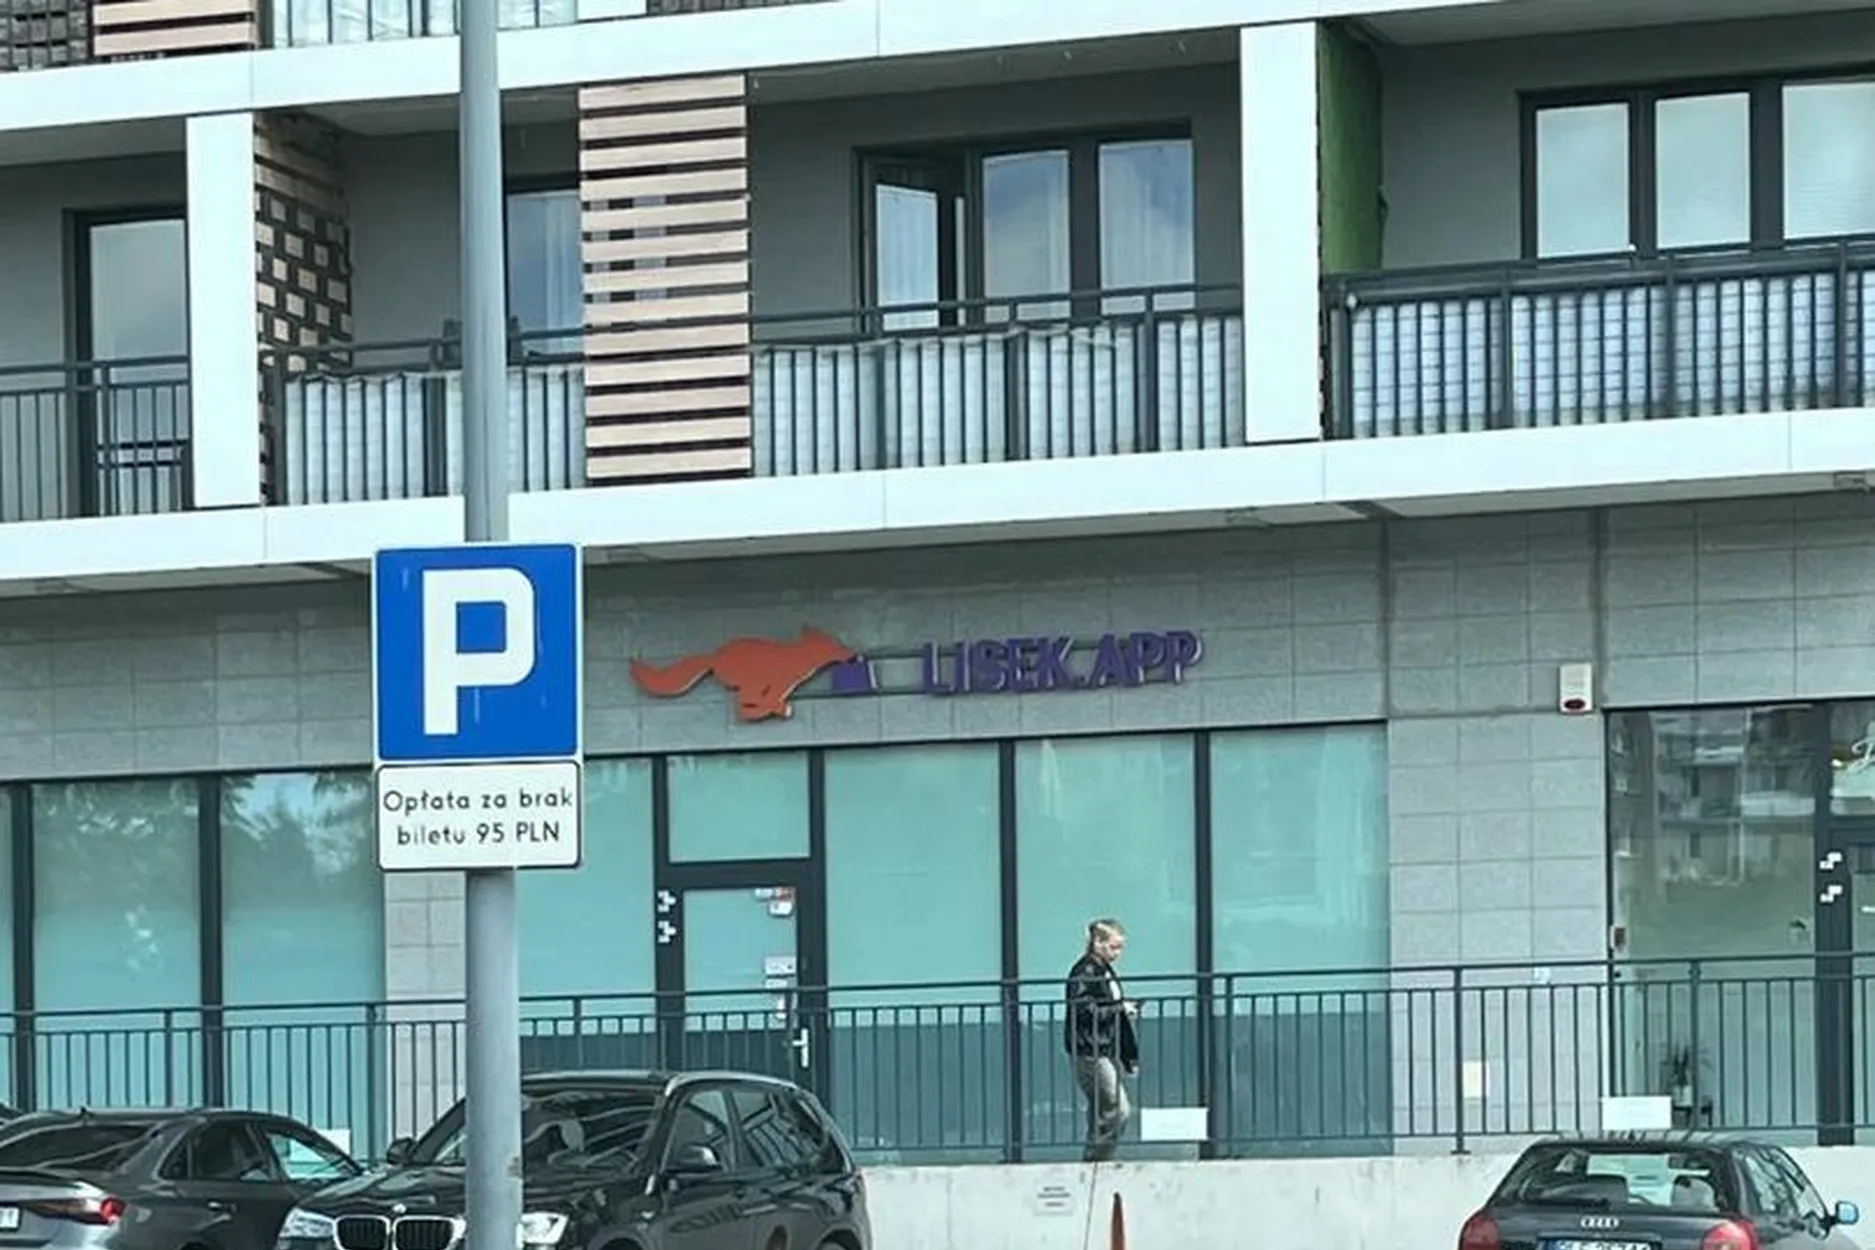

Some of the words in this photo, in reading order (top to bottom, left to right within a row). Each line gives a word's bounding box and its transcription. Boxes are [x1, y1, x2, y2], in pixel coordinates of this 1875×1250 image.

[423, 567, 535, 735] P
[383, 790, 470, 816] Opłata
[482, 792, 508, 809] za
[519, 788, 573, 808] brak
[397, 825, 467, 846] biletu
[477, 823, 505, 843] 95
[516, 822, 560, 842] PLN
